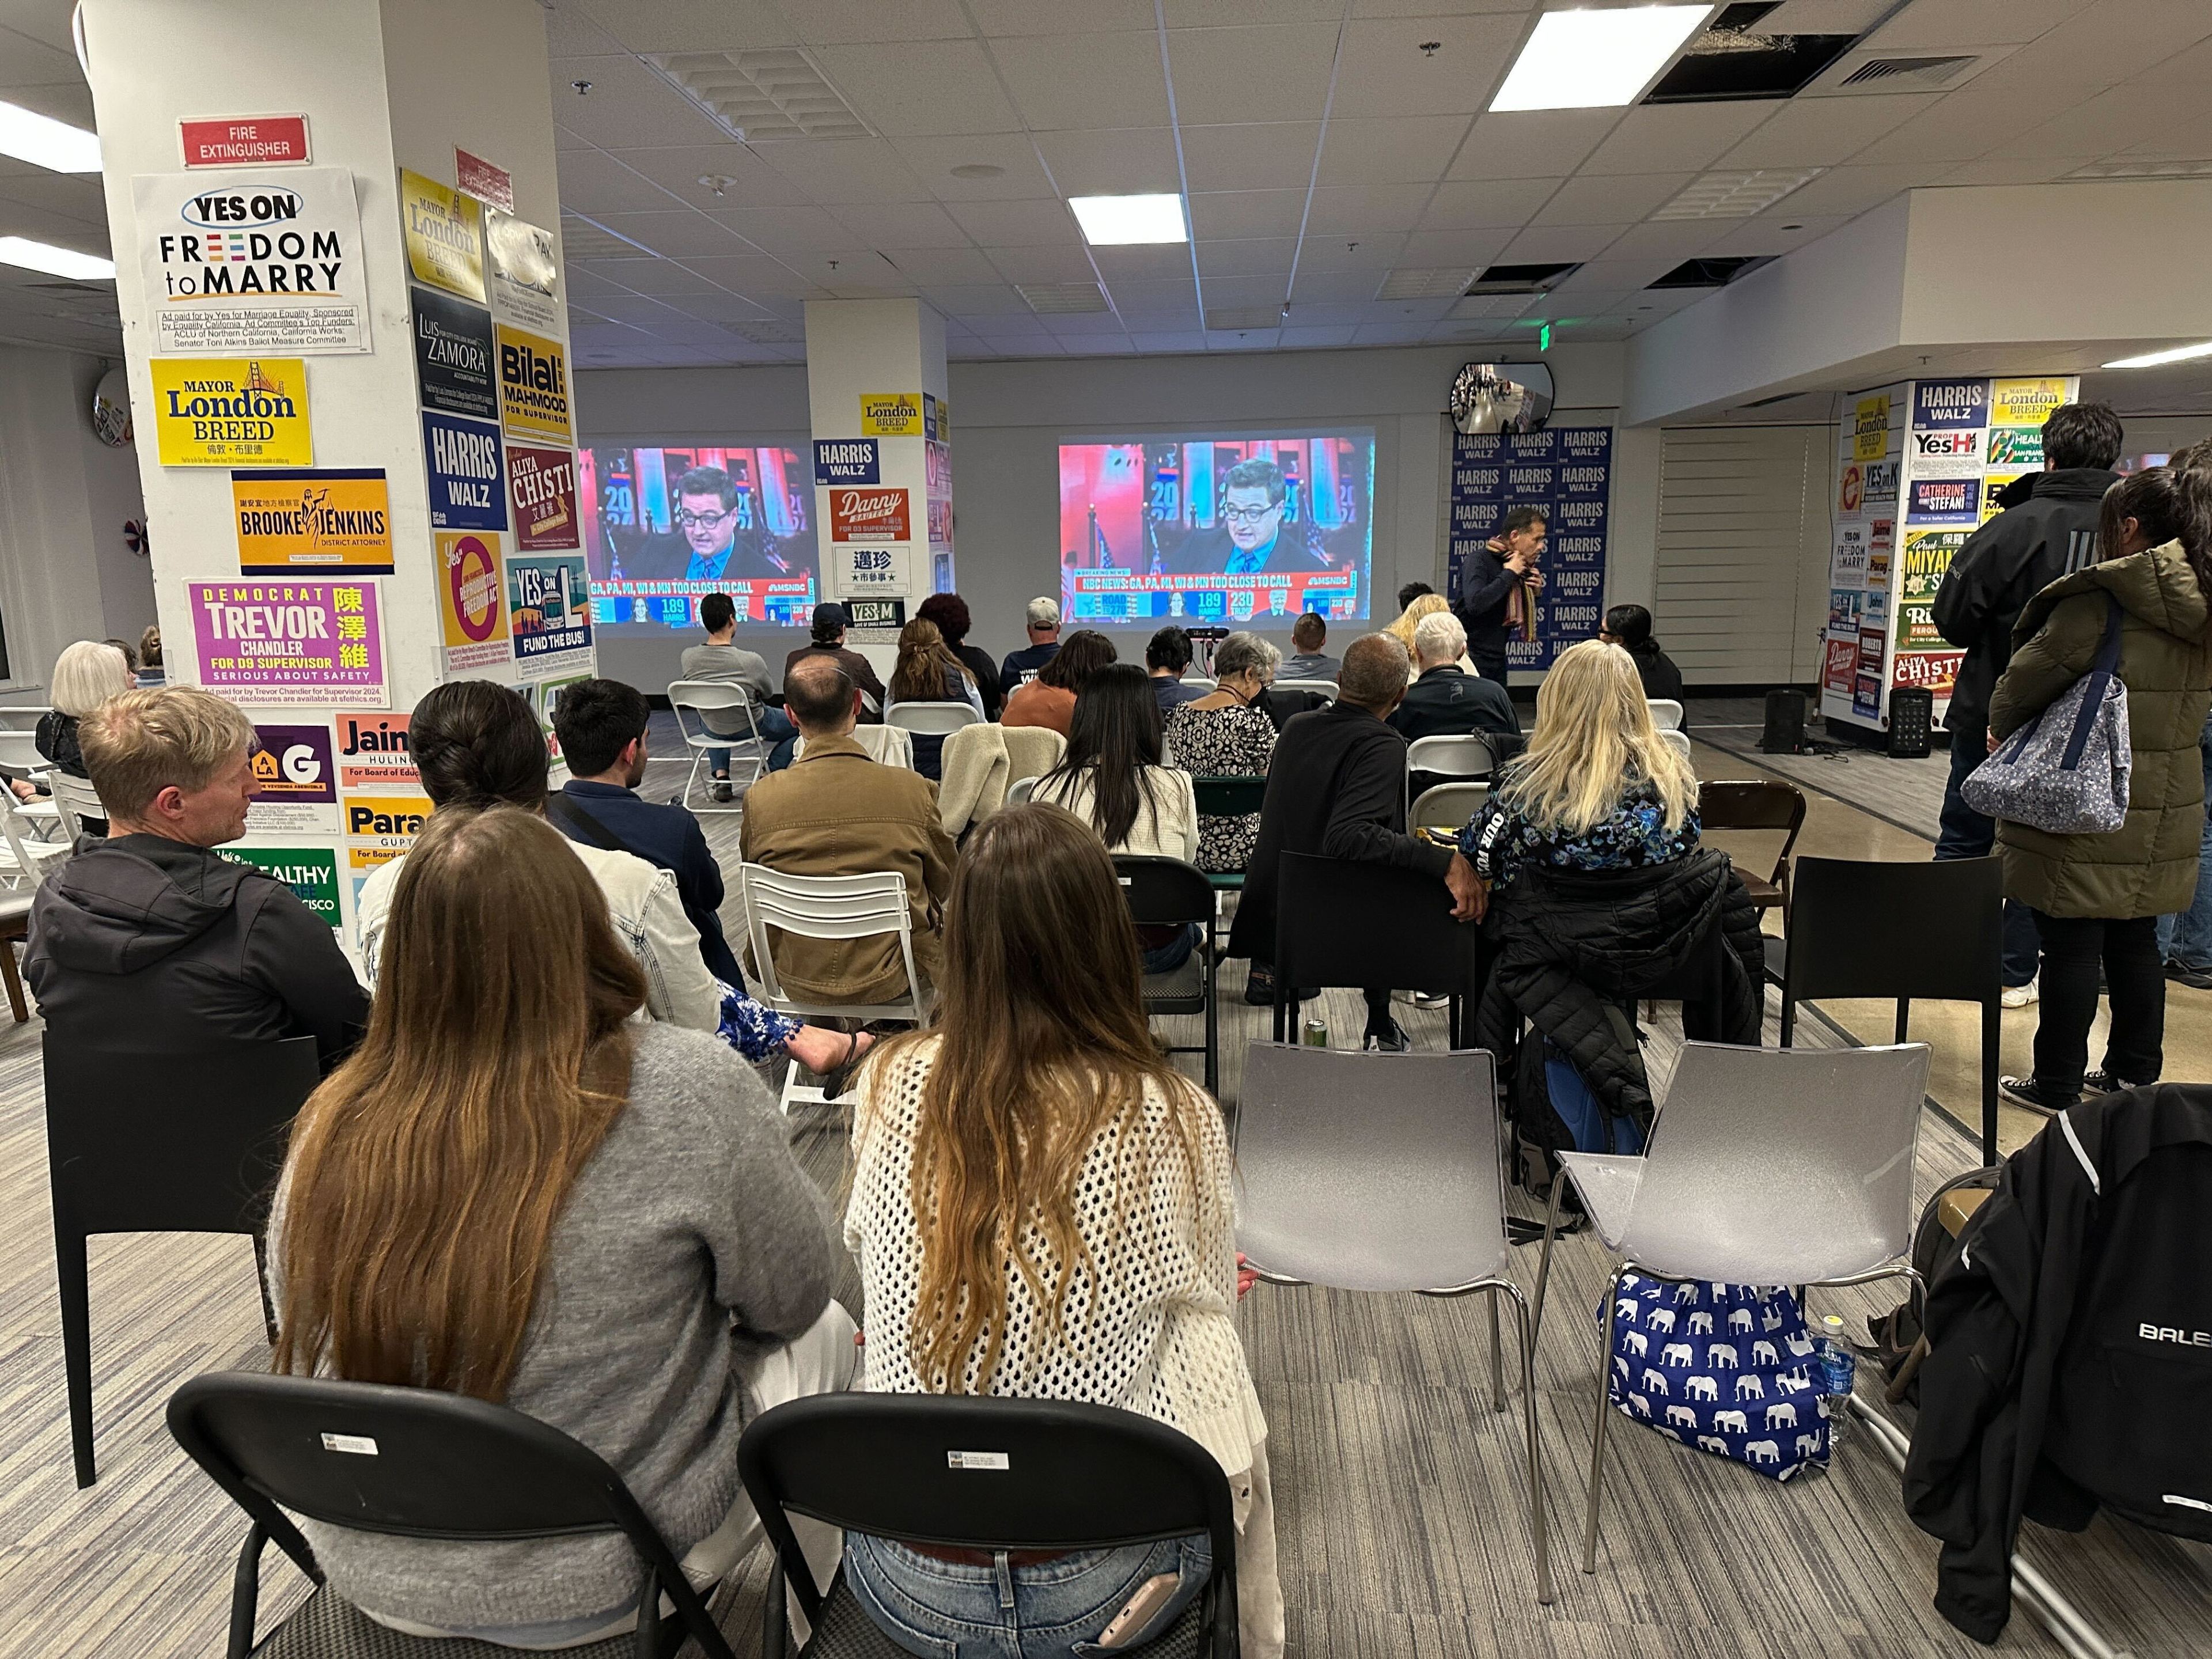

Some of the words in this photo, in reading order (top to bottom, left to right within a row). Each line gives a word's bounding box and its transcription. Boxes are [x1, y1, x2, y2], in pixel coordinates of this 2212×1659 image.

[230, 126, 257, 140] FIRE
[200, 142, 290, 159] EXTINGUISHER
[194, 196, 247, 221] YES
[250, 195, 296, 219] ON
[419, 198, 445, 219] MAYOR
[411, 203, 475, 254] London
[160, 231, 341, 263] FREEDOM
[425, 239, 466, 271] BREED
[282, 327, 317, 335] California
[419, 313, 439, 339] LUIS
[306, 336, 346, 344] Committee
[428, 337, 485, 373] ZAMORA
[502, 344, 558, 394] Bilal
[184, 381, 234, 392] MAYOR
[167, 389, 296, 417] London
[504, 385, 566, 412] MAHMOOD
[1922, 385, 1982, 407] HARRIS
[2000, 392, 2058, 404] London
[506, 405, 520, 414] FOR
[524, 409, 567, 425] SUPERVISOR
[866, 406, 917, 417] London
[1931, 408, 1971, 420] WALZ
[2010, 405, 2047, 414] BREED
[876, 418, 908, 426] BREED
[1855, 415, 1887, 434] London
[193, 422, 274, 440] BREED
[1458, 435, 1500, 449] HARRIS
[1510, 432, 1554, 448] HARRIS
[1564, 431, 1607, 447] HARRIS
[1860, 433, 1880, 447] BREED
[1915, 434, 1952, 453] Yes
[1953, 434, 1971, 452] H
[433, 427, 497, 480] HARRIS
[820, 444, 872, 464] HARRIS
[1464, 450, 1493, 459] WALZ
[1518, 448, 1546, 457] WALZ
[512, 456, 538, 478] ALIYA
[830, 465, 865, 476] WALZ
[1457, 469, 1499, 485] HARRIS
[1509, 468, 1552, 484] HARRIS
[1562, 467, 1605, 483] HARRIS
[1867, 466, 1883, 487] YES
[1891, 464, 1898, 485] K
[513, 463, 573, 509] CHISTI
[1463, 486, 1492, 494] WALZ
[1516, 484, 1544, 493] WALZ
[1569, 483, 1597, 491] WALZ
[1919, 484, 1966, 497] CATHERINE
[448, 481, 490, 507] WALZ
[605, 486, 631, 513] 20
[1152, 482, 1178, 507] 20
[839, 491, 902, 517] Danny
[1560, 502, 1603, 517] HARRIS
[1929, 497, 1964, 510] STEFANI
[1456, 505, 1497, 520] HARRIS
[241, 512, 303, 536] BROOKE
[320, 510, 385, 535] JENKINS
[1462, 521, 1490, 529] WALZ
[1558, 537, 1601, 552] HARRIS
[1838, 546, 1865, 555] FREEDOM
[1912, 539, 1938, 551] Paul
[854, 551, 891, 570] 邁珍
[1565, 553, 1594, 561] WALZ
[1843, 556, 1865, 567] MARRY
[1870, 560, 1887, 574] Parag
[460, 570, 497, 602] REPRODUCTIVE
[1083, 578, 1100, 589] NBC
[1102, 577, 1128, 589] NEWS:
[1129, 577, 1144, 590] GA,
[1229, 576, 1256, 588] CLOSE
[1257, 576, 1268, 588] TO
[1270, 575, 1292, 587] CALL
[1556, 572, 1600, 587] HARRIS
[203, 588, 322, 602] DEMOCRAT
[692, 582, 717, 594] CLOSE
[719, 582, 730, 593] TO
[731, 581, 753, 593] CALL
[463, 590, 489, 618] FREEDOM
[516, 568, 541, 607] YES
[544, 577, 555, 590] ON
[560, 566, 584, 628] L
[1103, 594, 1126, 604] ROAD
[1199, 593, 1221, 607] 189
[1230, 592, 1253, 606] 230
[661, 599, 684, 613] 189
[854, 605, 876, 620] YES
[881, 603, 893, 619] M
[1111, 605, 1126, 615] 270
[1199, 607, 1221, 615] HARRIS
[1230, 607, 1252, 615] TRUMP
[204, 603, 329, 639] TREVOR
[1555, 607, 1597, 621] HARRIS
[1561, 622, 1590, 630] WALZ
[240, 641, 304, 656] CHANDLER
[523, 637, 547, 653] FUND
[548, 635, 565, 648] THE
[566, 631, 584, 646] BUS!
[1508, 657, 1536, 665] WALZ
[1828, 642, 1854, 665] Danny
[211, 658, 234, 669] FOR
[238, 658, 254, 669] D9
[258, 658, 332, 669] SUPERVISOR
[1897, 656, 1926, 668] ALIYA
[213, 672, 268, 680] SERIOUS
[275, 672, 317, 680] ABOUT
[324, 672, 369, 680] SAFETY
[244, 688, 253, 696] by
[324, 688, 361, 696] Supervisor
[260, 757, 268, 765] A
[282, 744, 320, 785] G
[257, 766, 273, 774] LA
[1480, 813, 1504, 849] OUR
